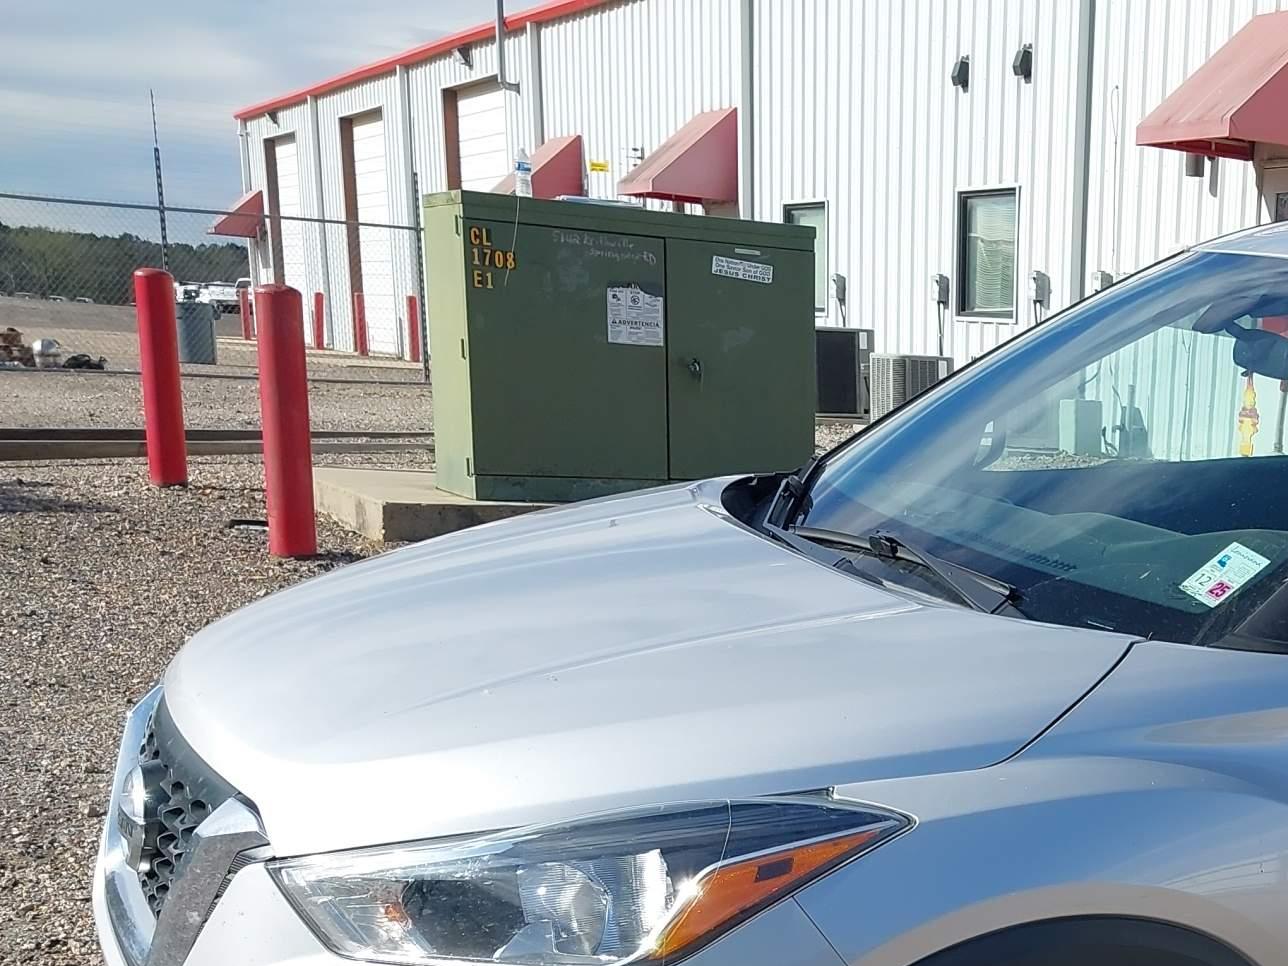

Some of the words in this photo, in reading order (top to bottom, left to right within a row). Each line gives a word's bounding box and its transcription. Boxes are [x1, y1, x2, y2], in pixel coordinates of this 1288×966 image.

[470, 227, 491, 246] CL
[472, 247, 515, 269] 1708
[473, 270, 493, 288] E1
[714, 268, 739, 277] JESUS
[742, 272, 771, 282] CHRIST
[618, 319, 660, 328] ADVERTENCIA
[1194, 573, 1212, 587] 12
[1208, 582, 1231, 598] 25
